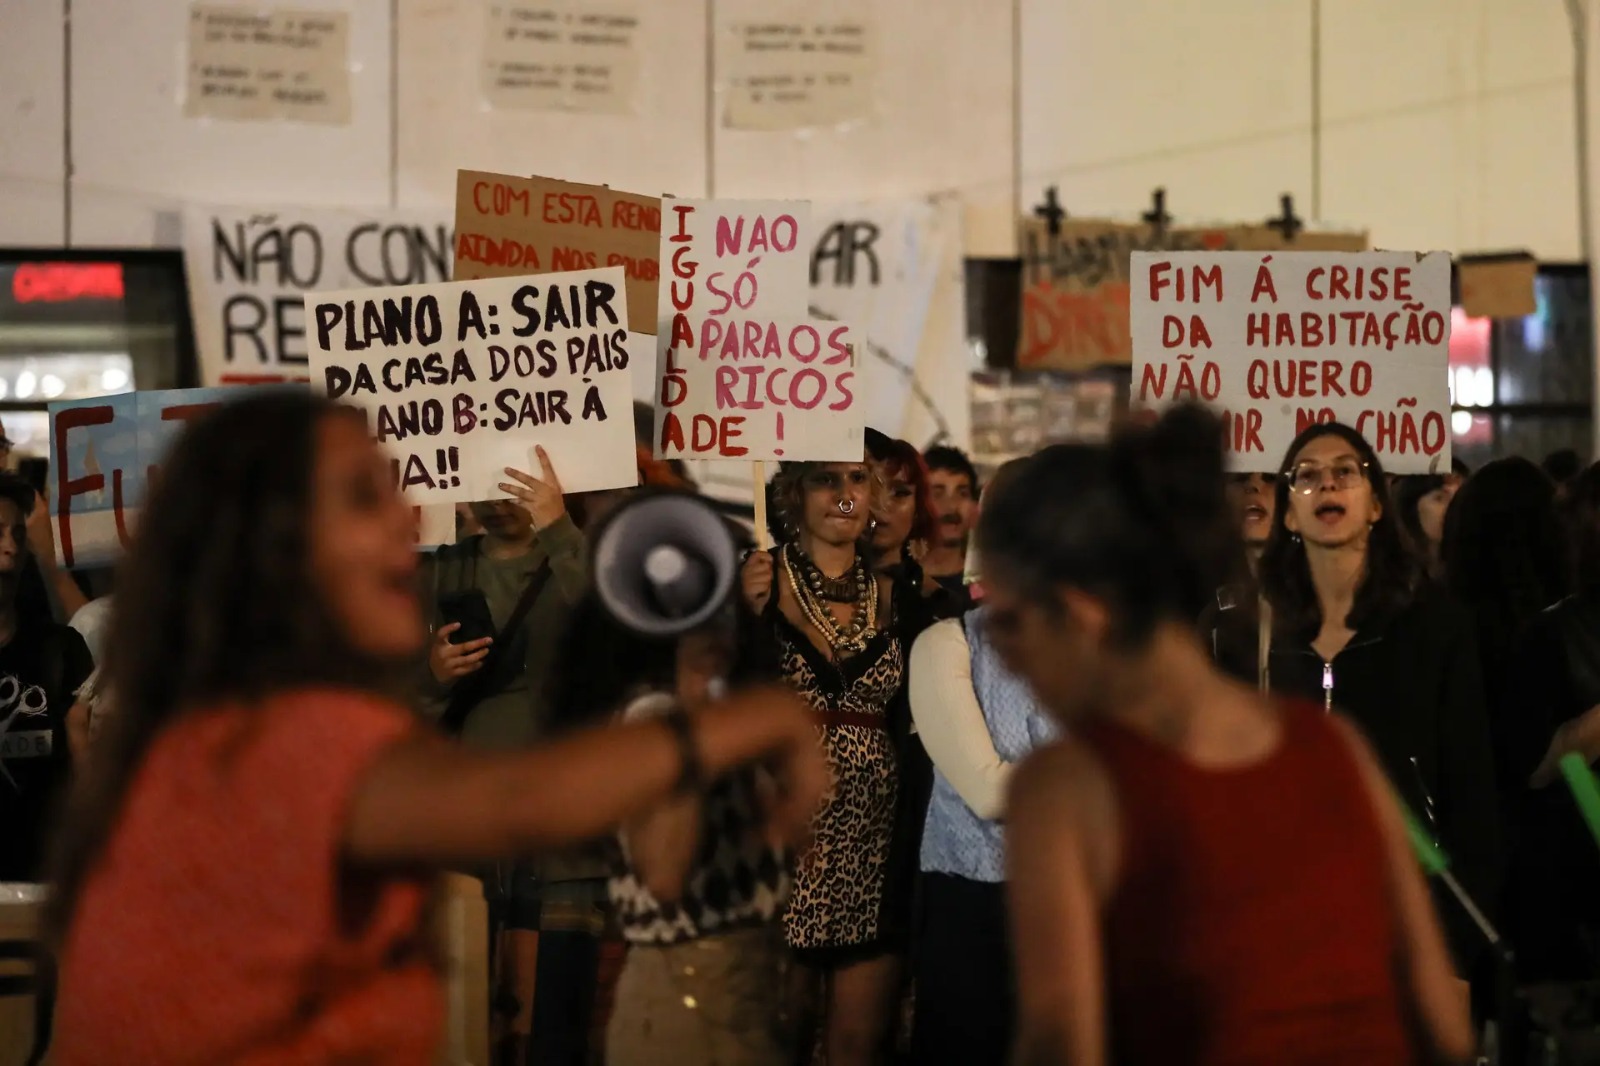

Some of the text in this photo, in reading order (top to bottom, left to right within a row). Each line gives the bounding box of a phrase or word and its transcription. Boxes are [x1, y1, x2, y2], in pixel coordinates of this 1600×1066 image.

[473, 181, 529, 217] COM
[543, 192, 603, 228] ESTA
[211, 213, 322, 288] NÃO
[346, 222, 455, 288] CON
[457, 233, 540, 270] AINDA
[552, 246, 597, 273] NOS
[716, 214, 798, 258] NAO
[706, 256, 761, 315] SÓ
[1149, 255, 1413, 303] FIM Á CRISE
[315, 280, 619, 351] PLANO A: SAIR
[1162, 302, 1445, 351] DA HABITAÇÃO
[488, 339, 557, 382] DOS
[565, 328, 629, 377] PAIS
[1140, 354, 1372, 401] NÃO QUERO
[452, 392, 488, 435] B:
[493, 388, 572, 432] SAIR
[715, 365, 855, 411] RICOS
[1356, 396, 1446, 457] CHÃO
[391, 446, 460, 493] A!!
